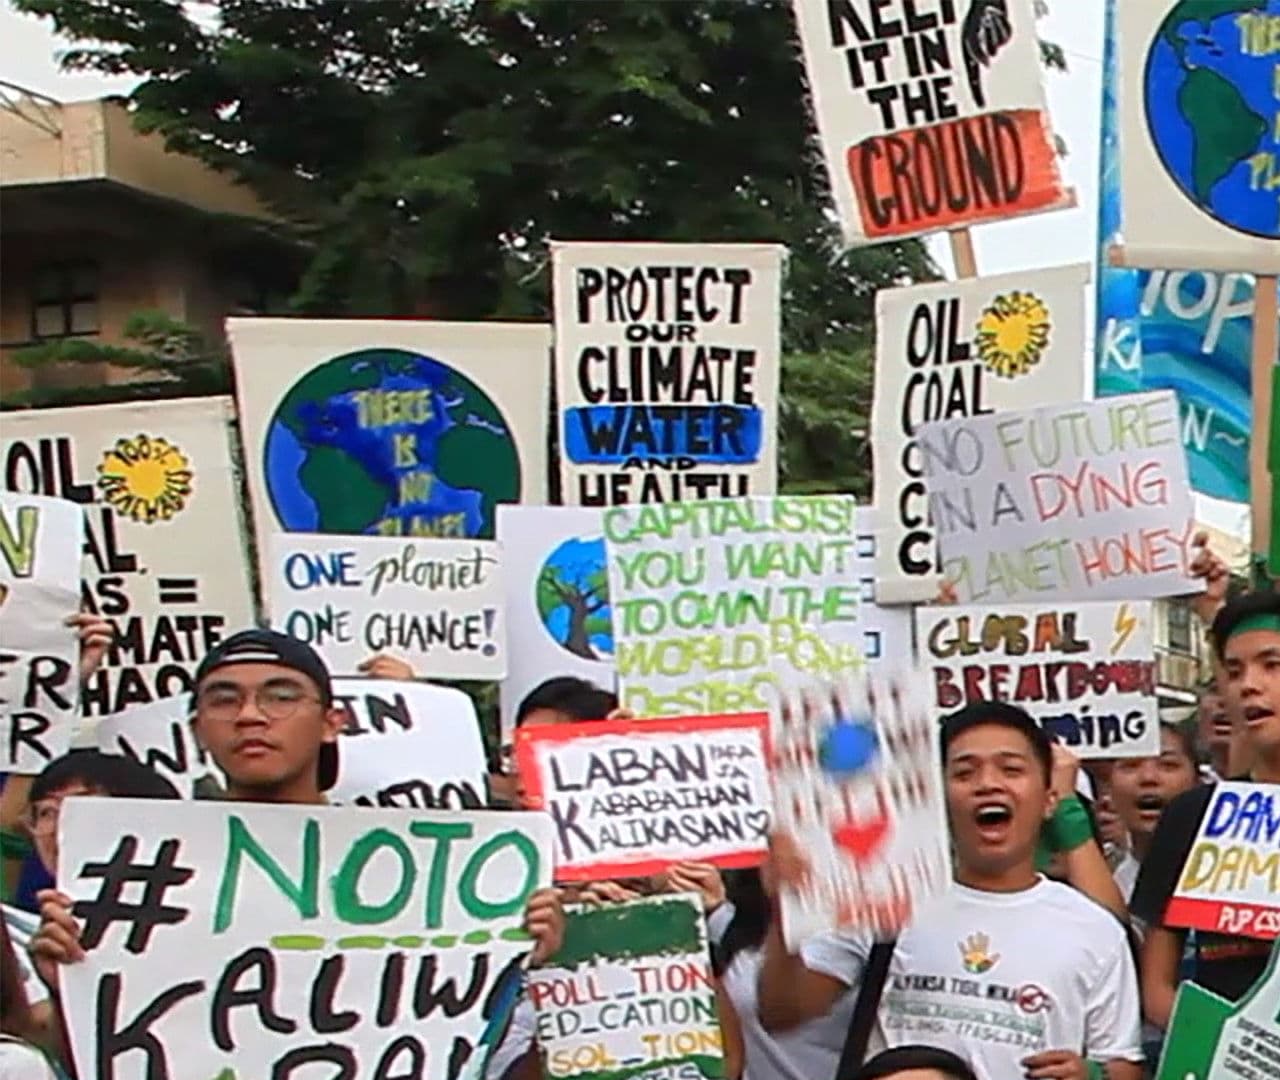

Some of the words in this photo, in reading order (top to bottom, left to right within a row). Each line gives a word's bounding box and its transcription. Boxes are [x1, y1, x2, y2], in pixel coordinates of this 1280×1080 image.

[846, 42, 889, 88] IT
[902, 29, 952, 77] IN
[867, 76, 958, 130] THE
[860, 112, 1024, 229] GROUND
[576, 266, 752, 324] PROTECT
[625, 324, 698, 343] OUR
[907, 298, 974, 368] OIL
[577, 346, 756, 405] CLIMATE
[578, 405, 747, 456] WATER
[915, 426, 983, 477] NO
[996, 398, 1175, 472] FUTURE
[6, 438, 94, 503] OIL
[621, 457, 698, 470] AND
[928, 487, 976, 532] IN
[992, 483, 1024, 525] A
[1030, 462, 1167, 521] DYING
[285, 552, 361, 590] ONE
[365, 544, 497, 596] planet
[617, 549, 704, 590] YOU
[726, 541, 854, 580] WANT
[942, 540, 1070, 600] PLANET
[1076, 518, 1200, 587] HONEY
[286, 604, 350, 645] ONE
[365, 608, 496, 657] CHANCE!
[616, 599, 666, 636] TO
[672, 587, 771, 628] OWN
[781, 585, 861, 622] THE
[928, 611, 1090, 658] GLOBAL
[550, 744, 707, 792] LABAN
[1217, 906, 1251, 933] PUP
